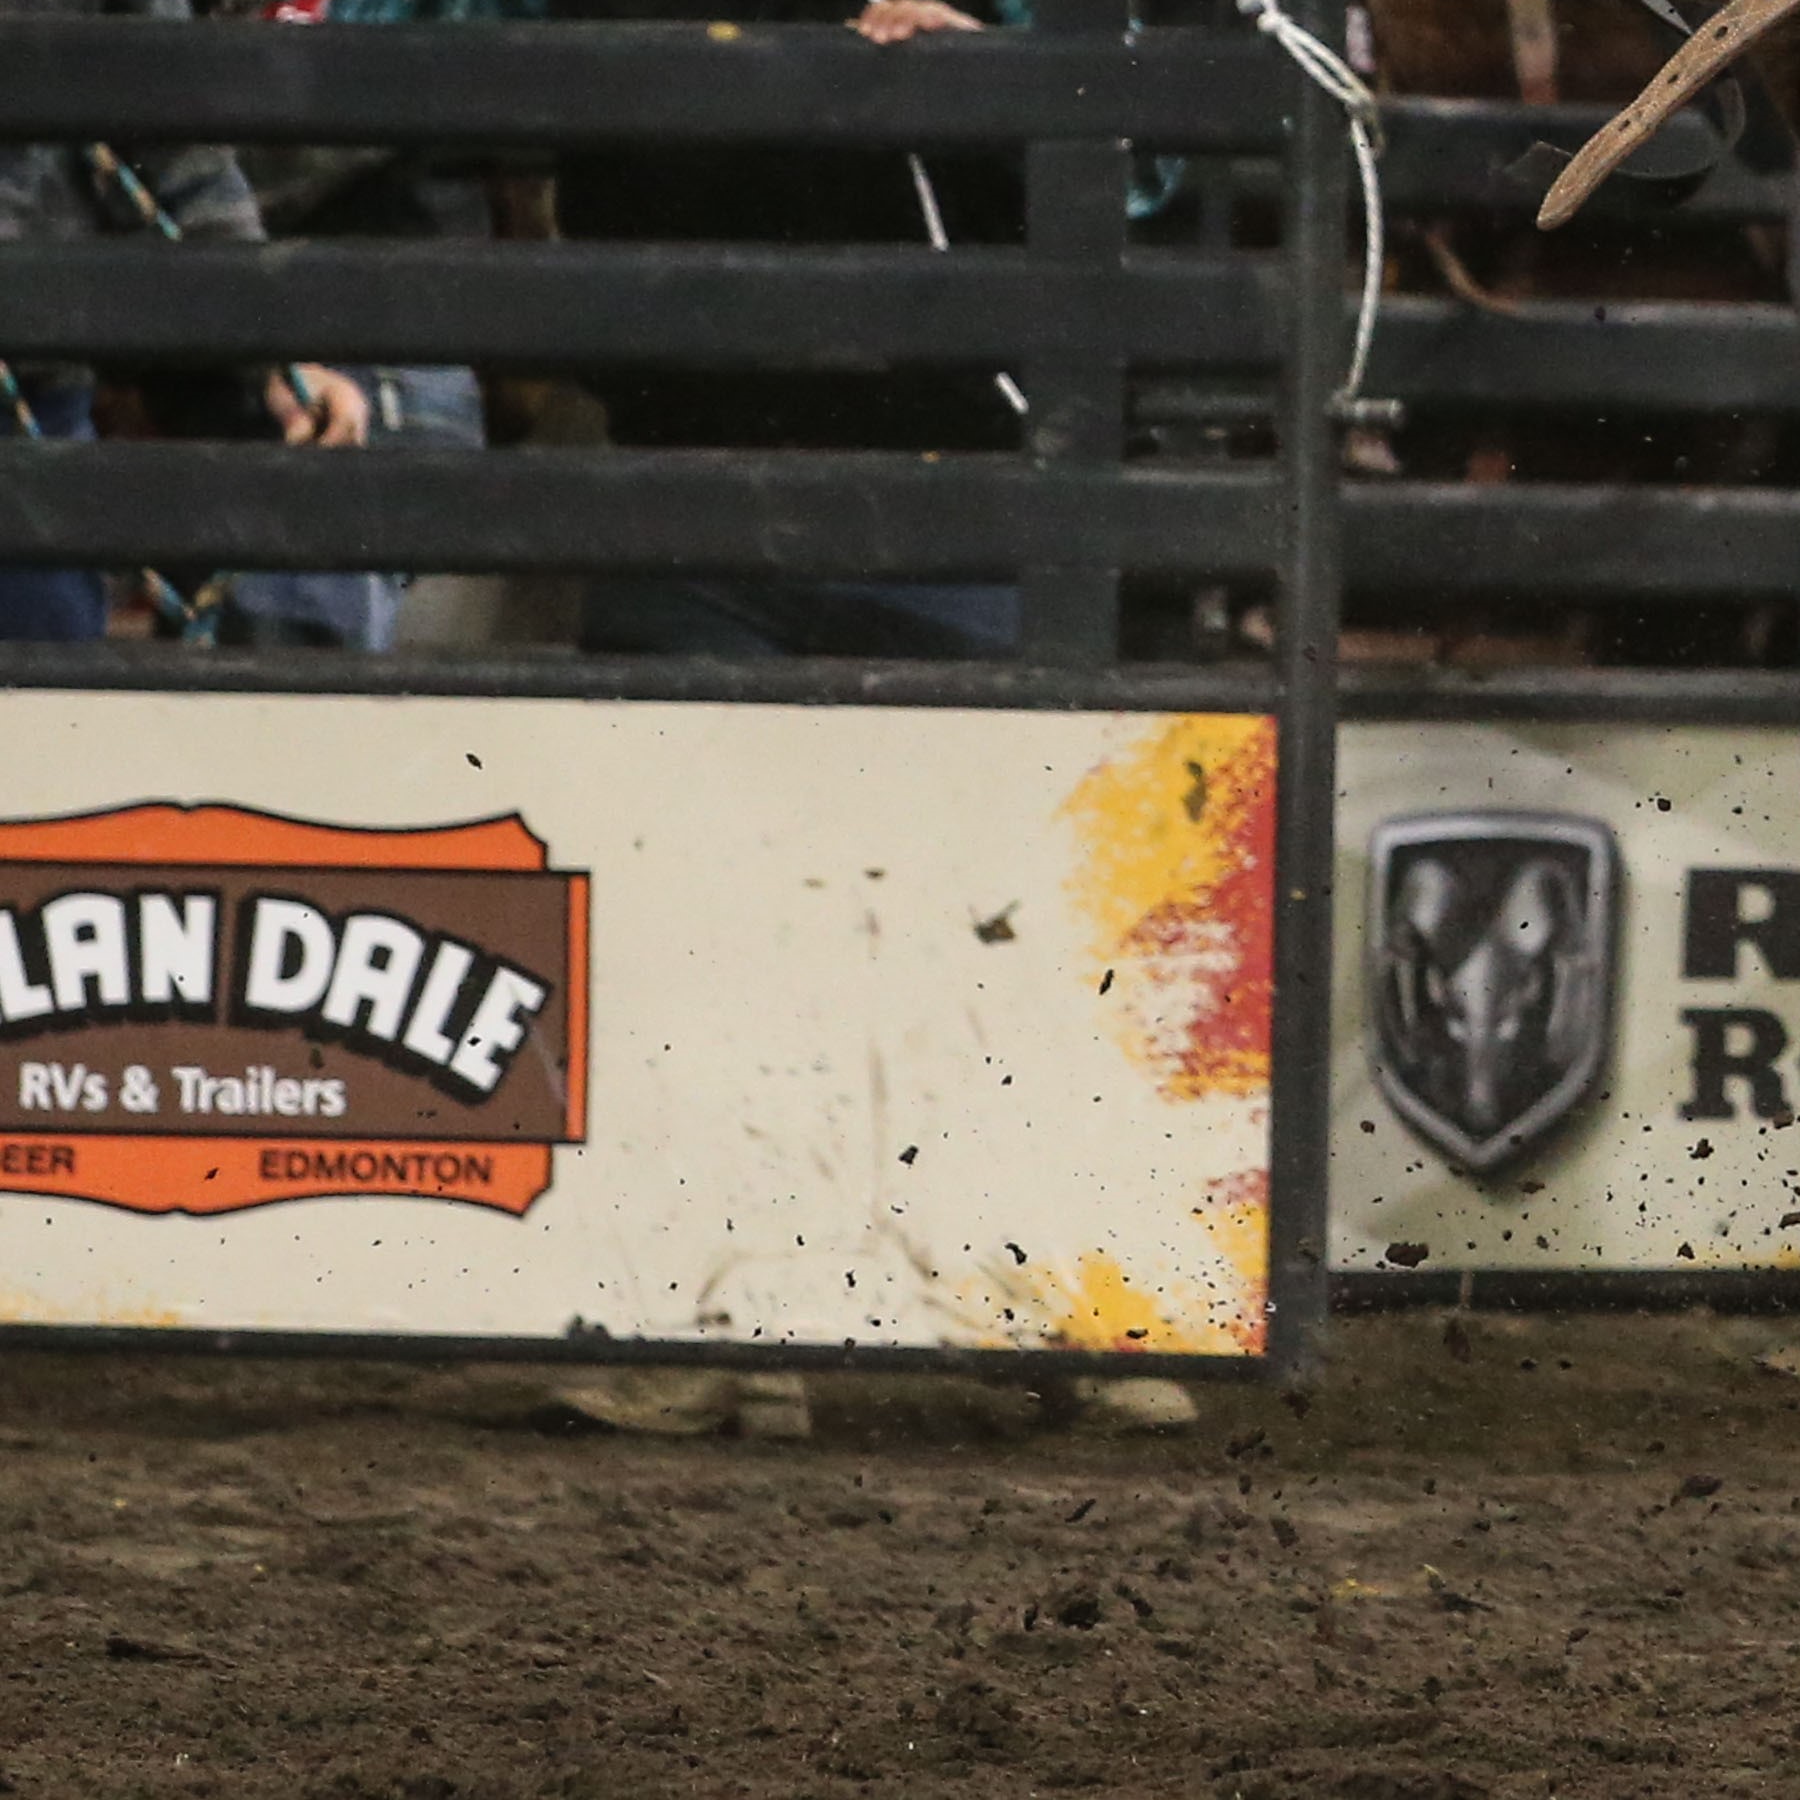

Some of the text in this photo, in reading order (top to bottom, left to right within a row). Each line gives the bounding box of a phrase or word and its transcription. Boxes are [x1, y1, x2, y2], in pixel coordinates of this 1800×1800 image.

[245, 898, 547, 1093] DALE
[20, 1062, 347, 1116] RVs & Trailers
[258, 1147, 494, 1185] EDMONTON
